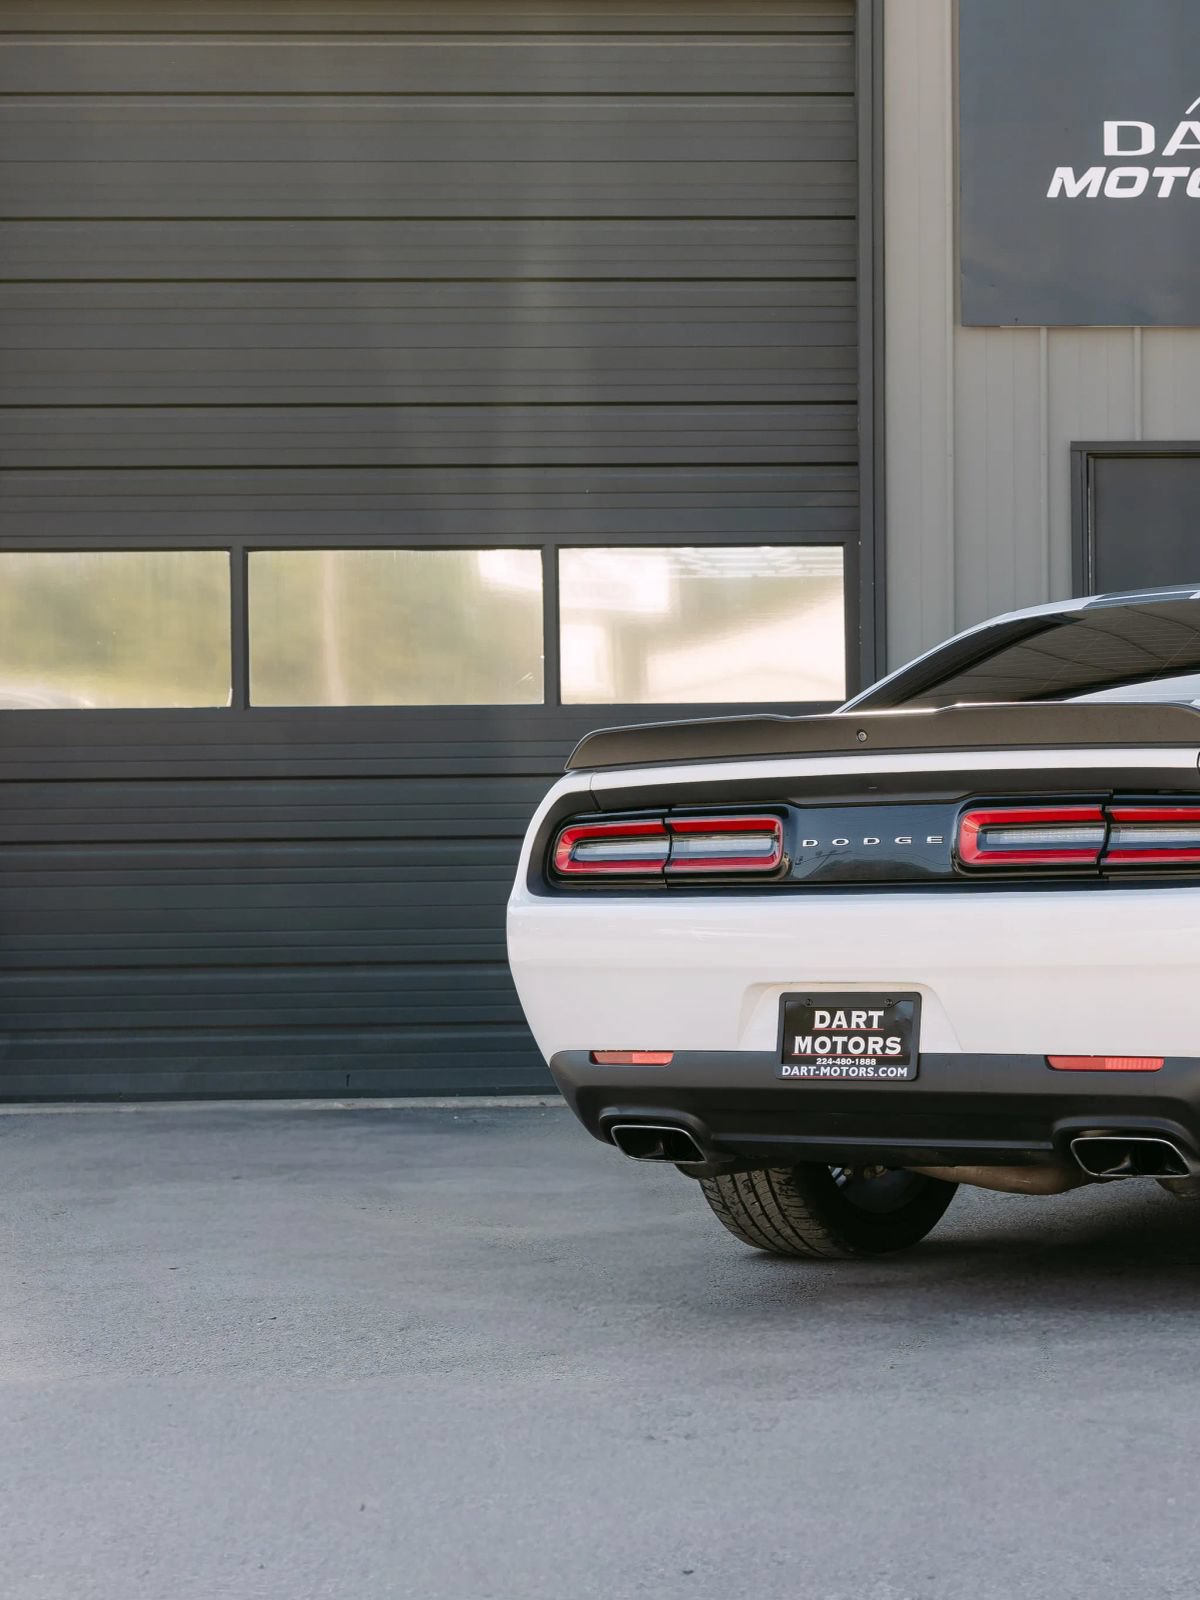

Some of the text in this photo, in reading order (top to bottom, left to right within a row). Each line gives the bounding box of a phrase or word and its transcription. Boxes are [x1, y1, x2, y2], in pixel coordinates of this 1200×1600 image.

[802, 836, 944, 847] DODGE
[814, 1010, 884, 1029] DART
[793, 1036, 902, 1055] MOTORS
[816, 1057, 877, 1066] 224-480-1888
[782, 1065, 908, 1077] DART-MOTORS.COM
